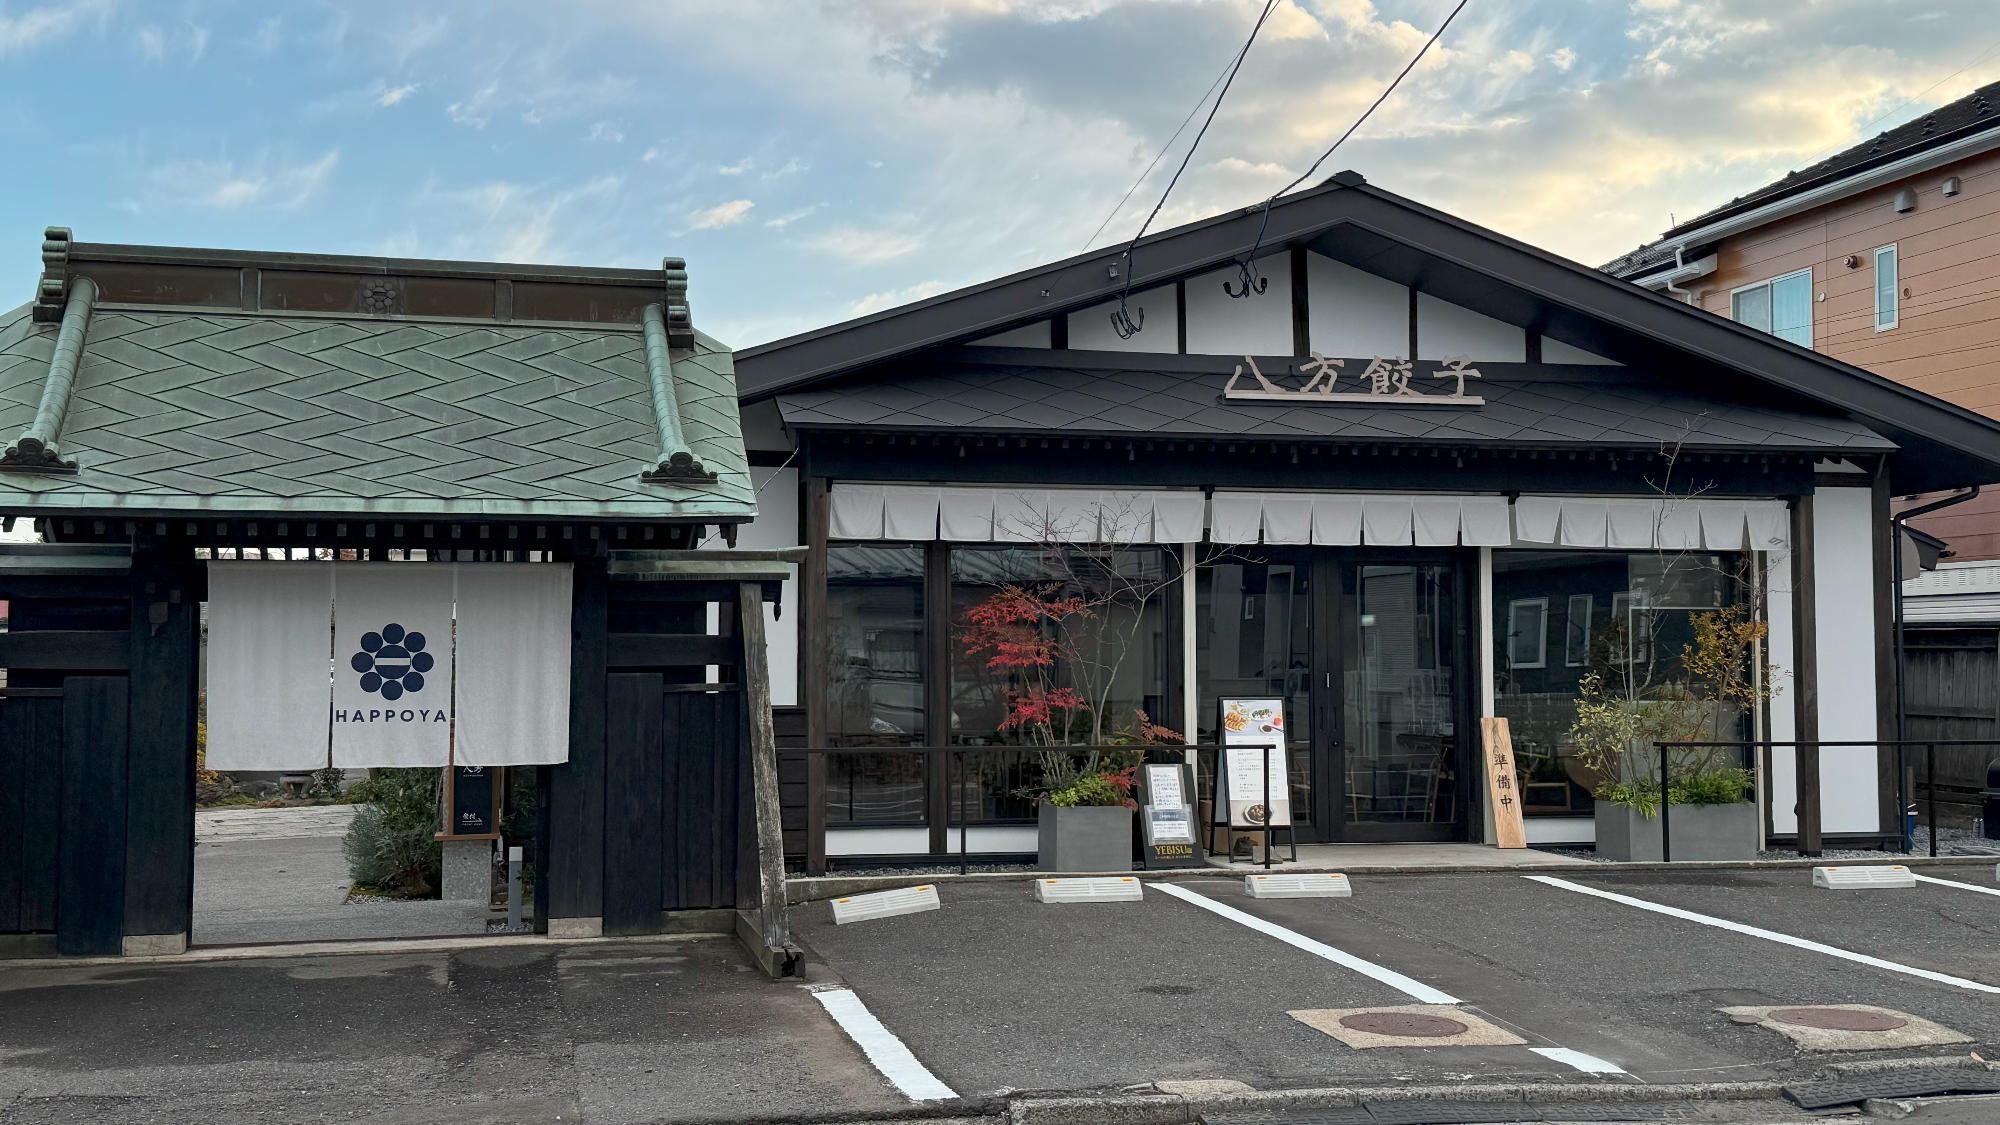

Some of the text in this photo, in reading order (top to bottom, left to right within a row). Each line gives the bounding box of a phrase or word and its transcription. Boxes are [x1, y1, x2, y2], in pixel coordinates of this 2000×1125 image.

[1223, 351, 1482, 399] 八方餃子
[335, 709, 447, 723] HAPPOYA
[1494, 753, 1512, 811] 準備中
[1154, 844, 1187, 855] YEBISU
